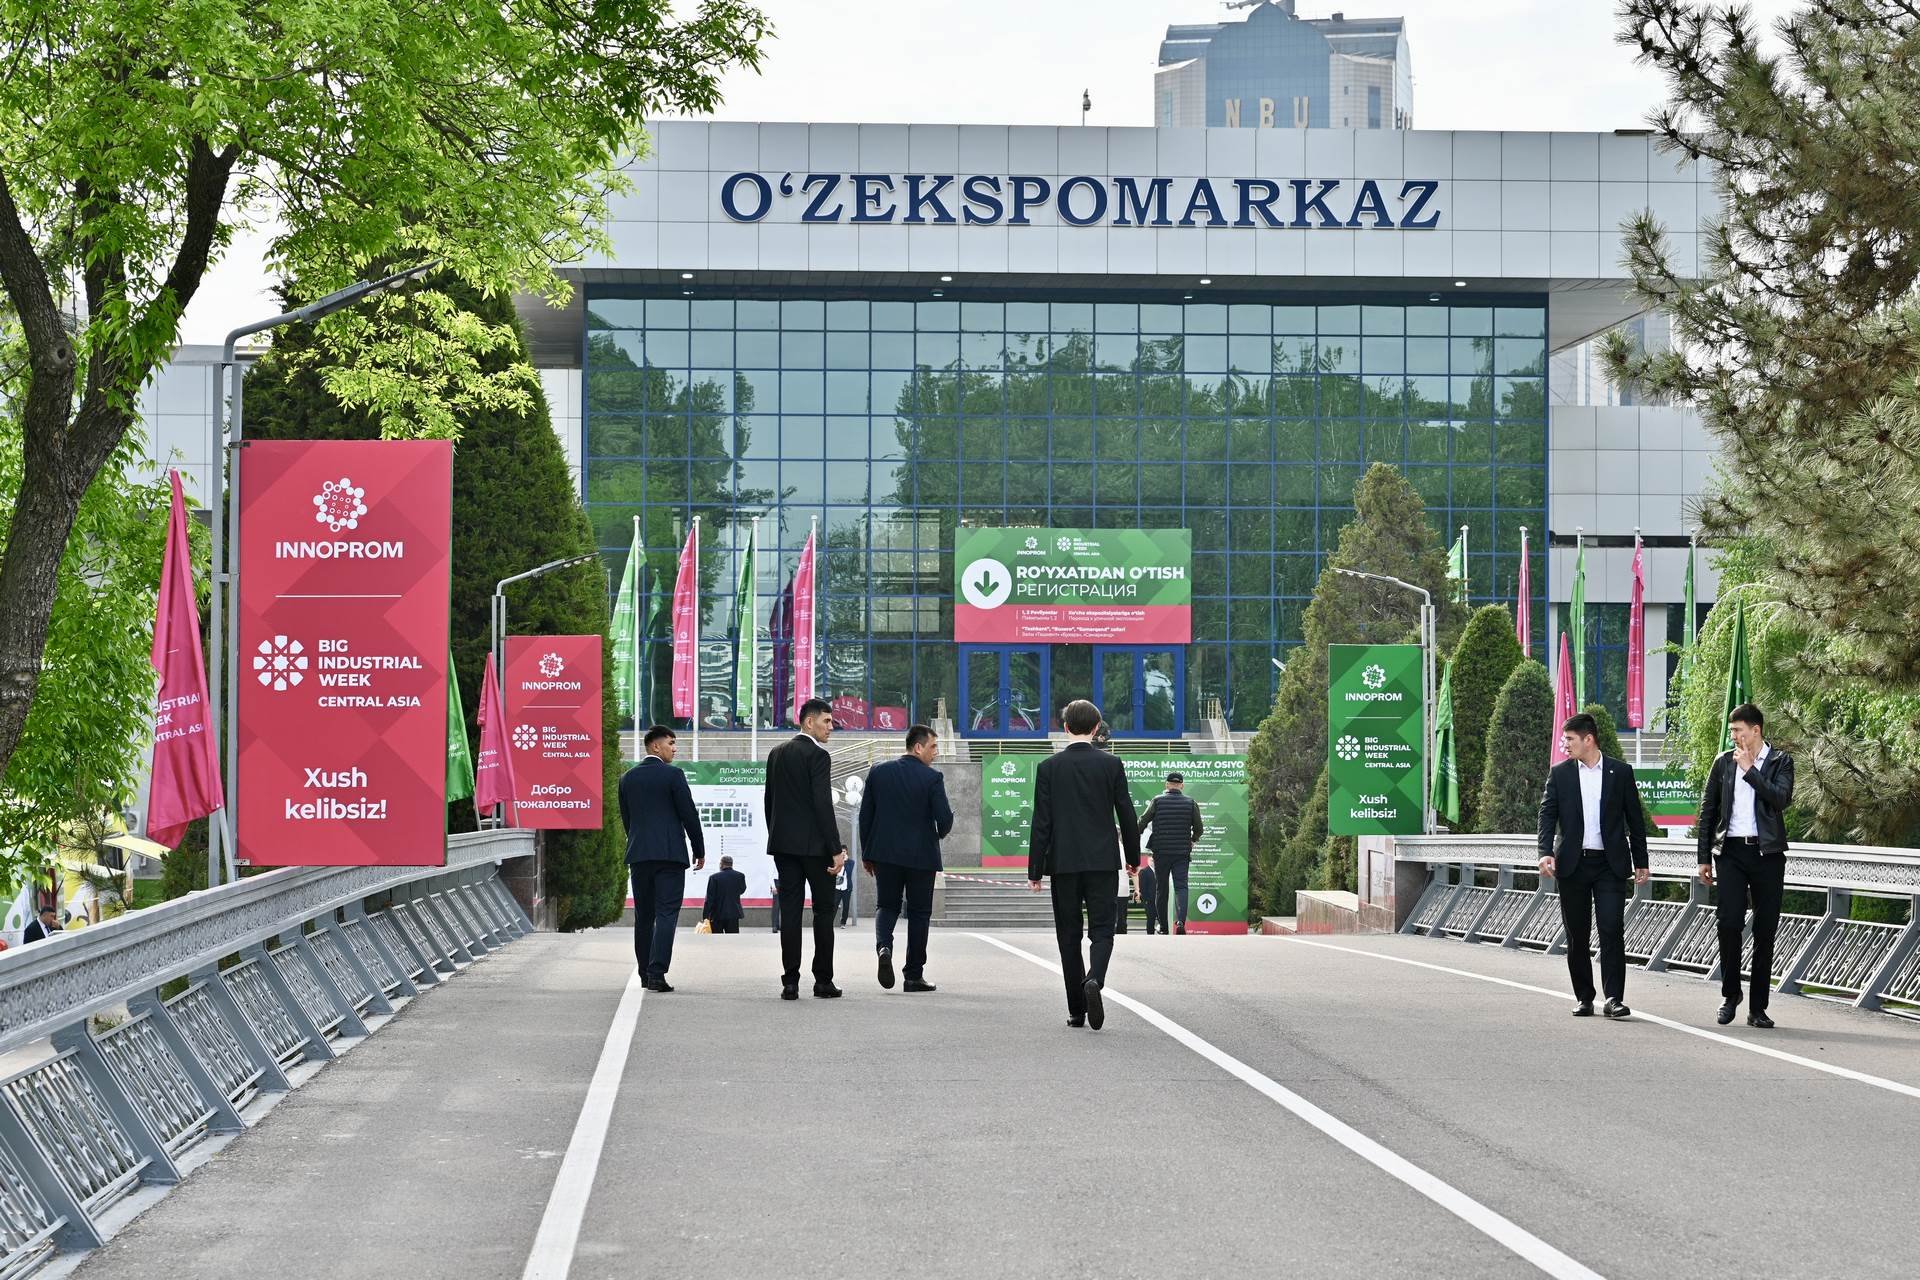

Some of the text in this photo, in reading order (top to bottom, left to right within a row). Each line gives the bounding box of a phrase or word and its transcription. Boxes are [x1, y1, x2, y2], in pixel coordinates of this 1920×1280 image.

[1225, 96, 1309, 128] NBU
[719, 171, 1441, 229] O‘ZEKSPOMARKAZ
[275, 541, 403, 558] INNOPROM
[1016, 566, 1184, 579] RO‘YXATDAN O‘TISH
[1017, 583, 1137, 598] РЕГИСТРАЦИЯ
[318, 639, 348, 652] BIG
[318, 656, 422, 669] INDUSTRIAL
[319, 673, 371, 687] WEEK
[522, 682, 581, 690] INNOPROM
[318, 696, 421, 707] CENTRAL ASIA
[1345, 693, 1402, 701] INNOPROM
[1161, 761, 1212, 769] MARKAZIY
[1214, 761, 1244, 769] OSIYO
[304, 767, 367, 788] Xush
[1157, 771, 1219, 780] ЦЕРАЛЬНАЯ
[531, 784, 571, 795] Добро
[514, 799, 591, 809] пожаловать!
[1359, 794, 1387, 804] Xush
[285, 797, 387, 819] kelibsiz!
[1350, 808, 1397, 819] kelibsiz!
